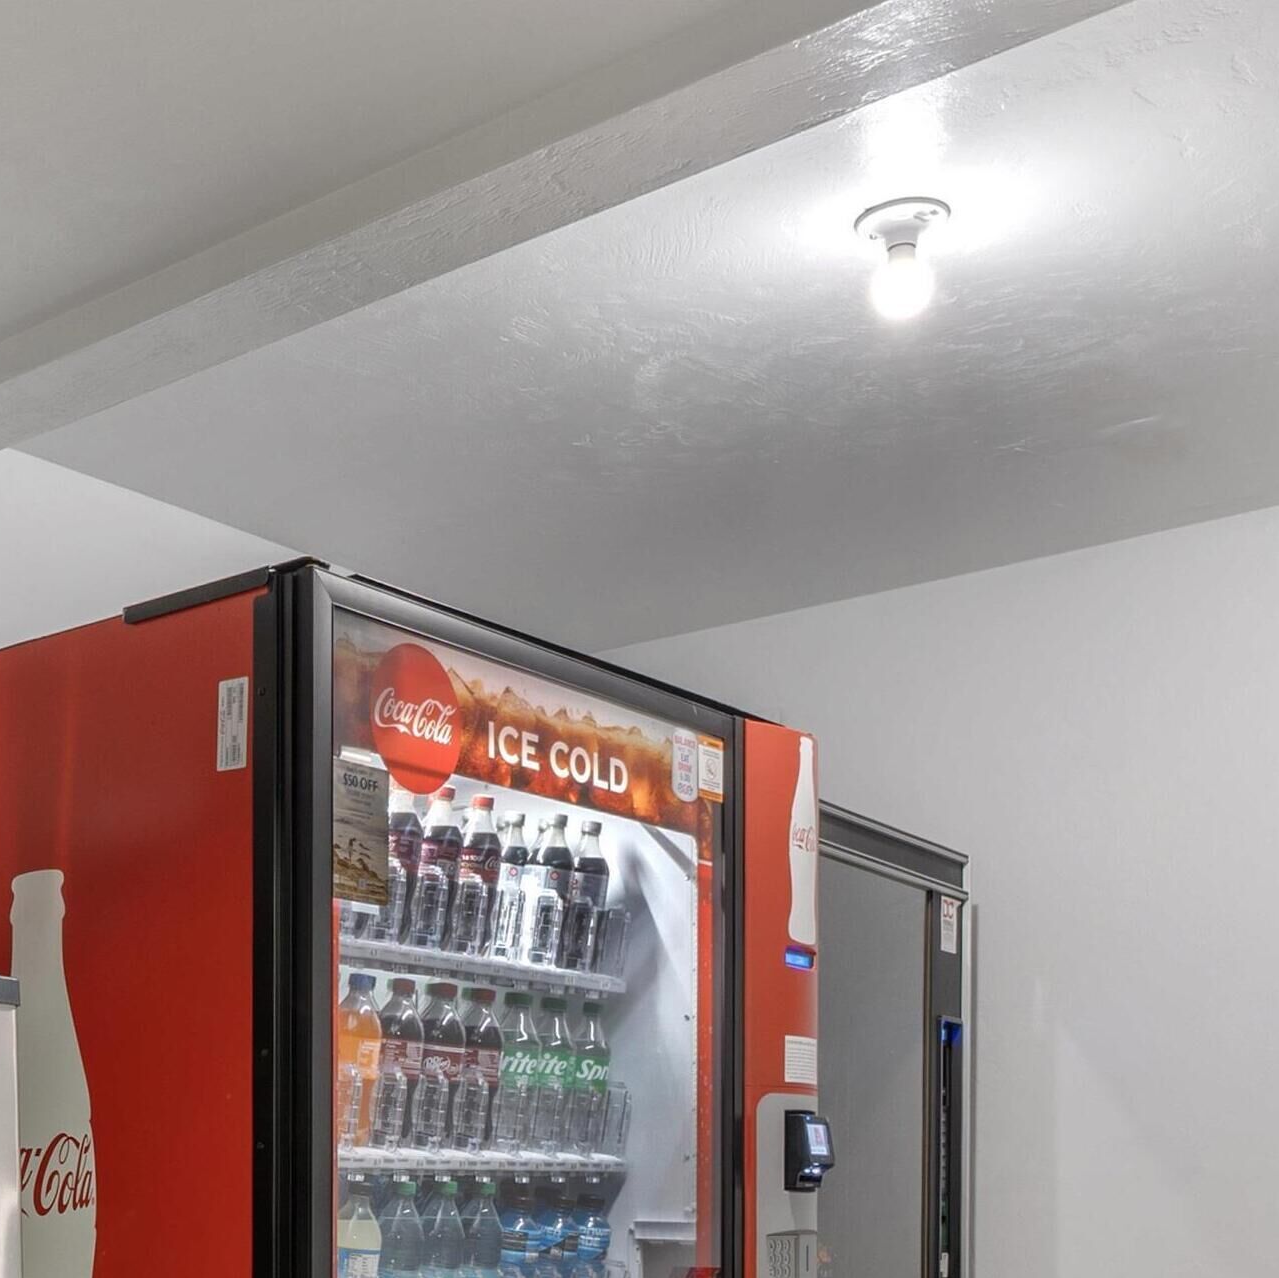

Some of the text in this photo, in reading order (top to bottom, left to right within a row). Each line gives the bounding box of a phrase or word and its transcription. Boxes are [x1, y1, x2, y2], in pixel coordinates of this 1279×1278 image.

[374, 687, 457, 747] Coca-Cola
[360, 777, 379, 793] OFF
[487, 720, 629, 795] ICE COLD
